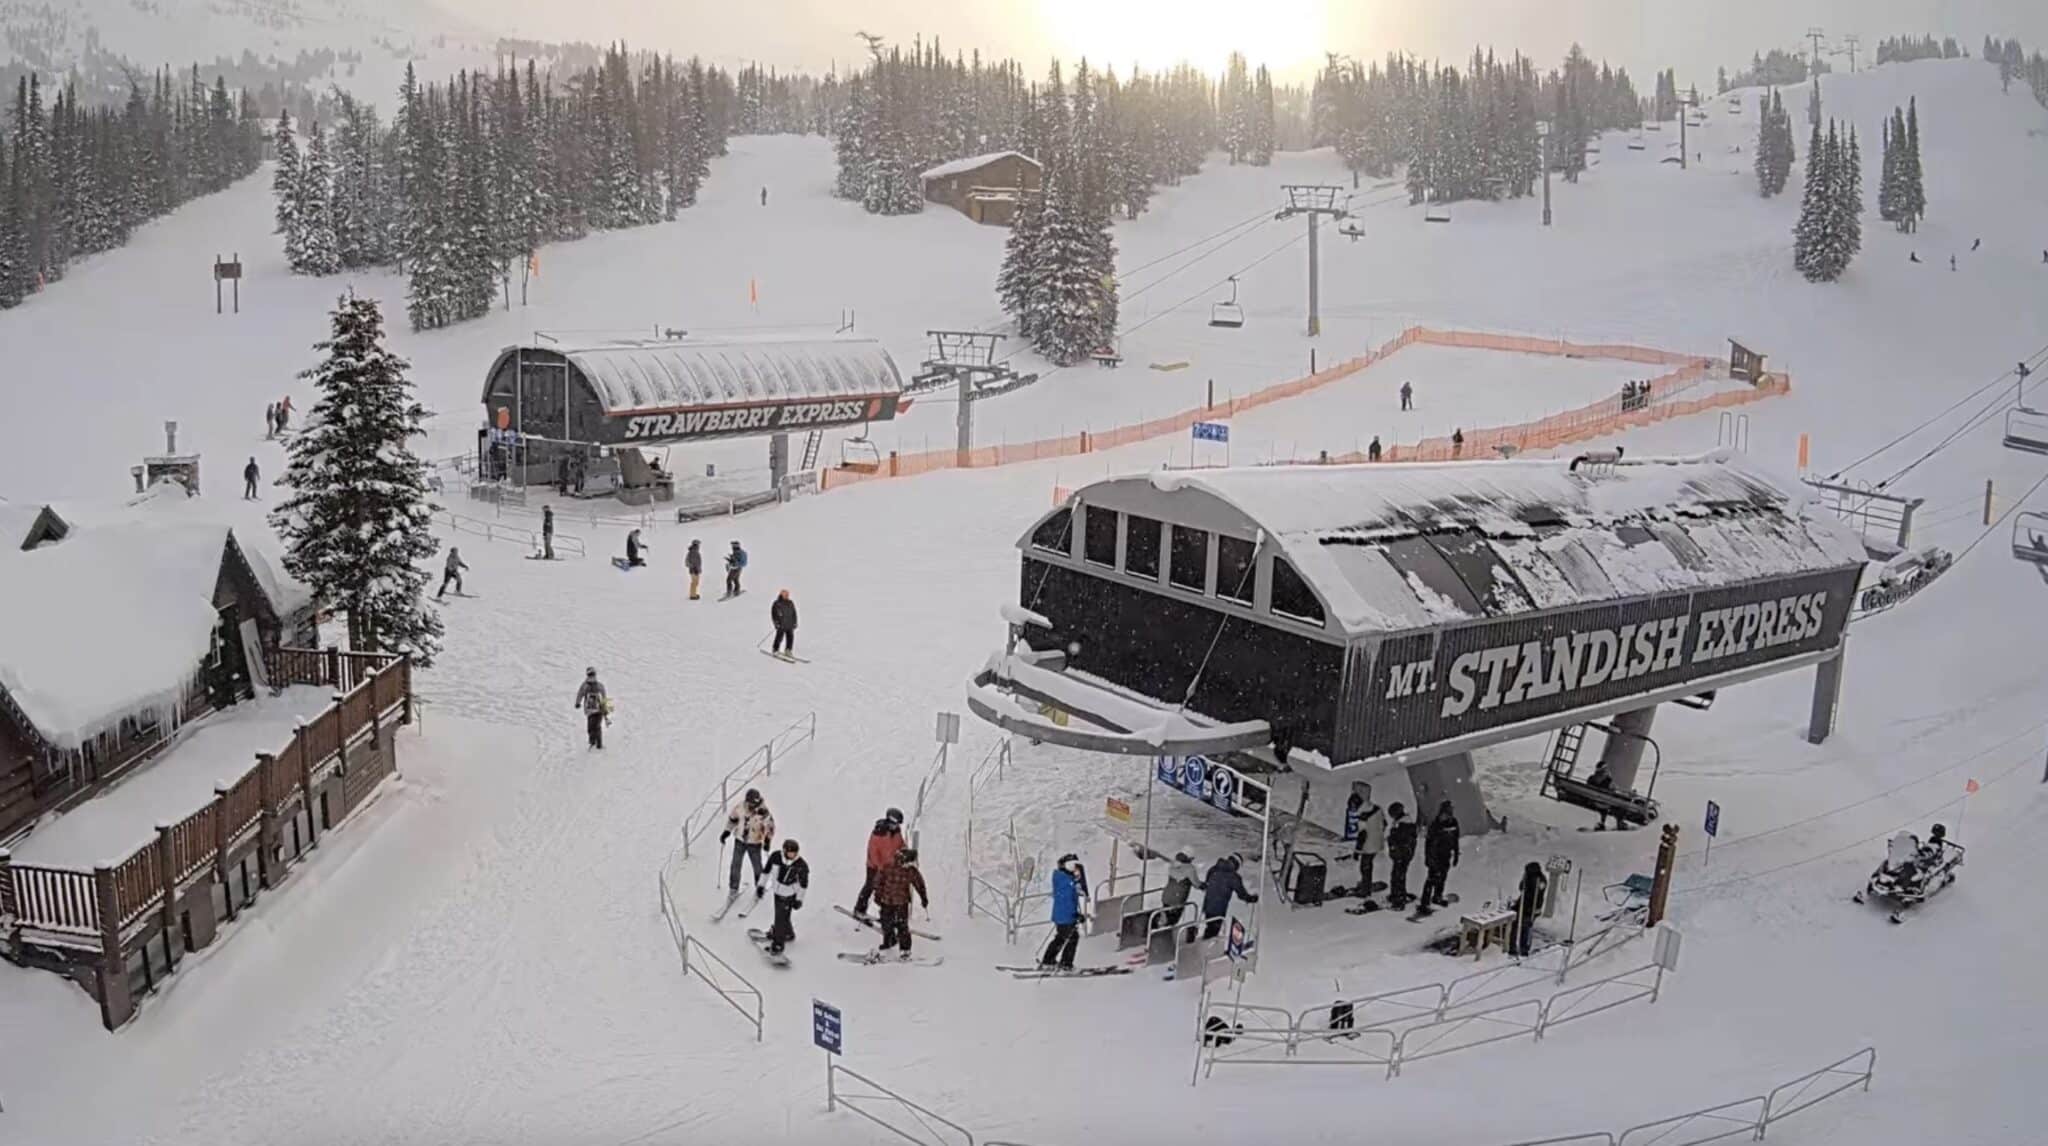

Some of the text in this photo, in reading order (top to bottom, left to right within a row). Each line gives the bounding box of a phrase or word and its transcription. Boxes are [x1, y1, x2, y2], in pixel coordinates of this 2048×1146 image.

[625, 401, 864, 439] STRAWBERRY EXPRESS
[1386, 592, 1826, 718] MT. STANDISH EXPRESS
